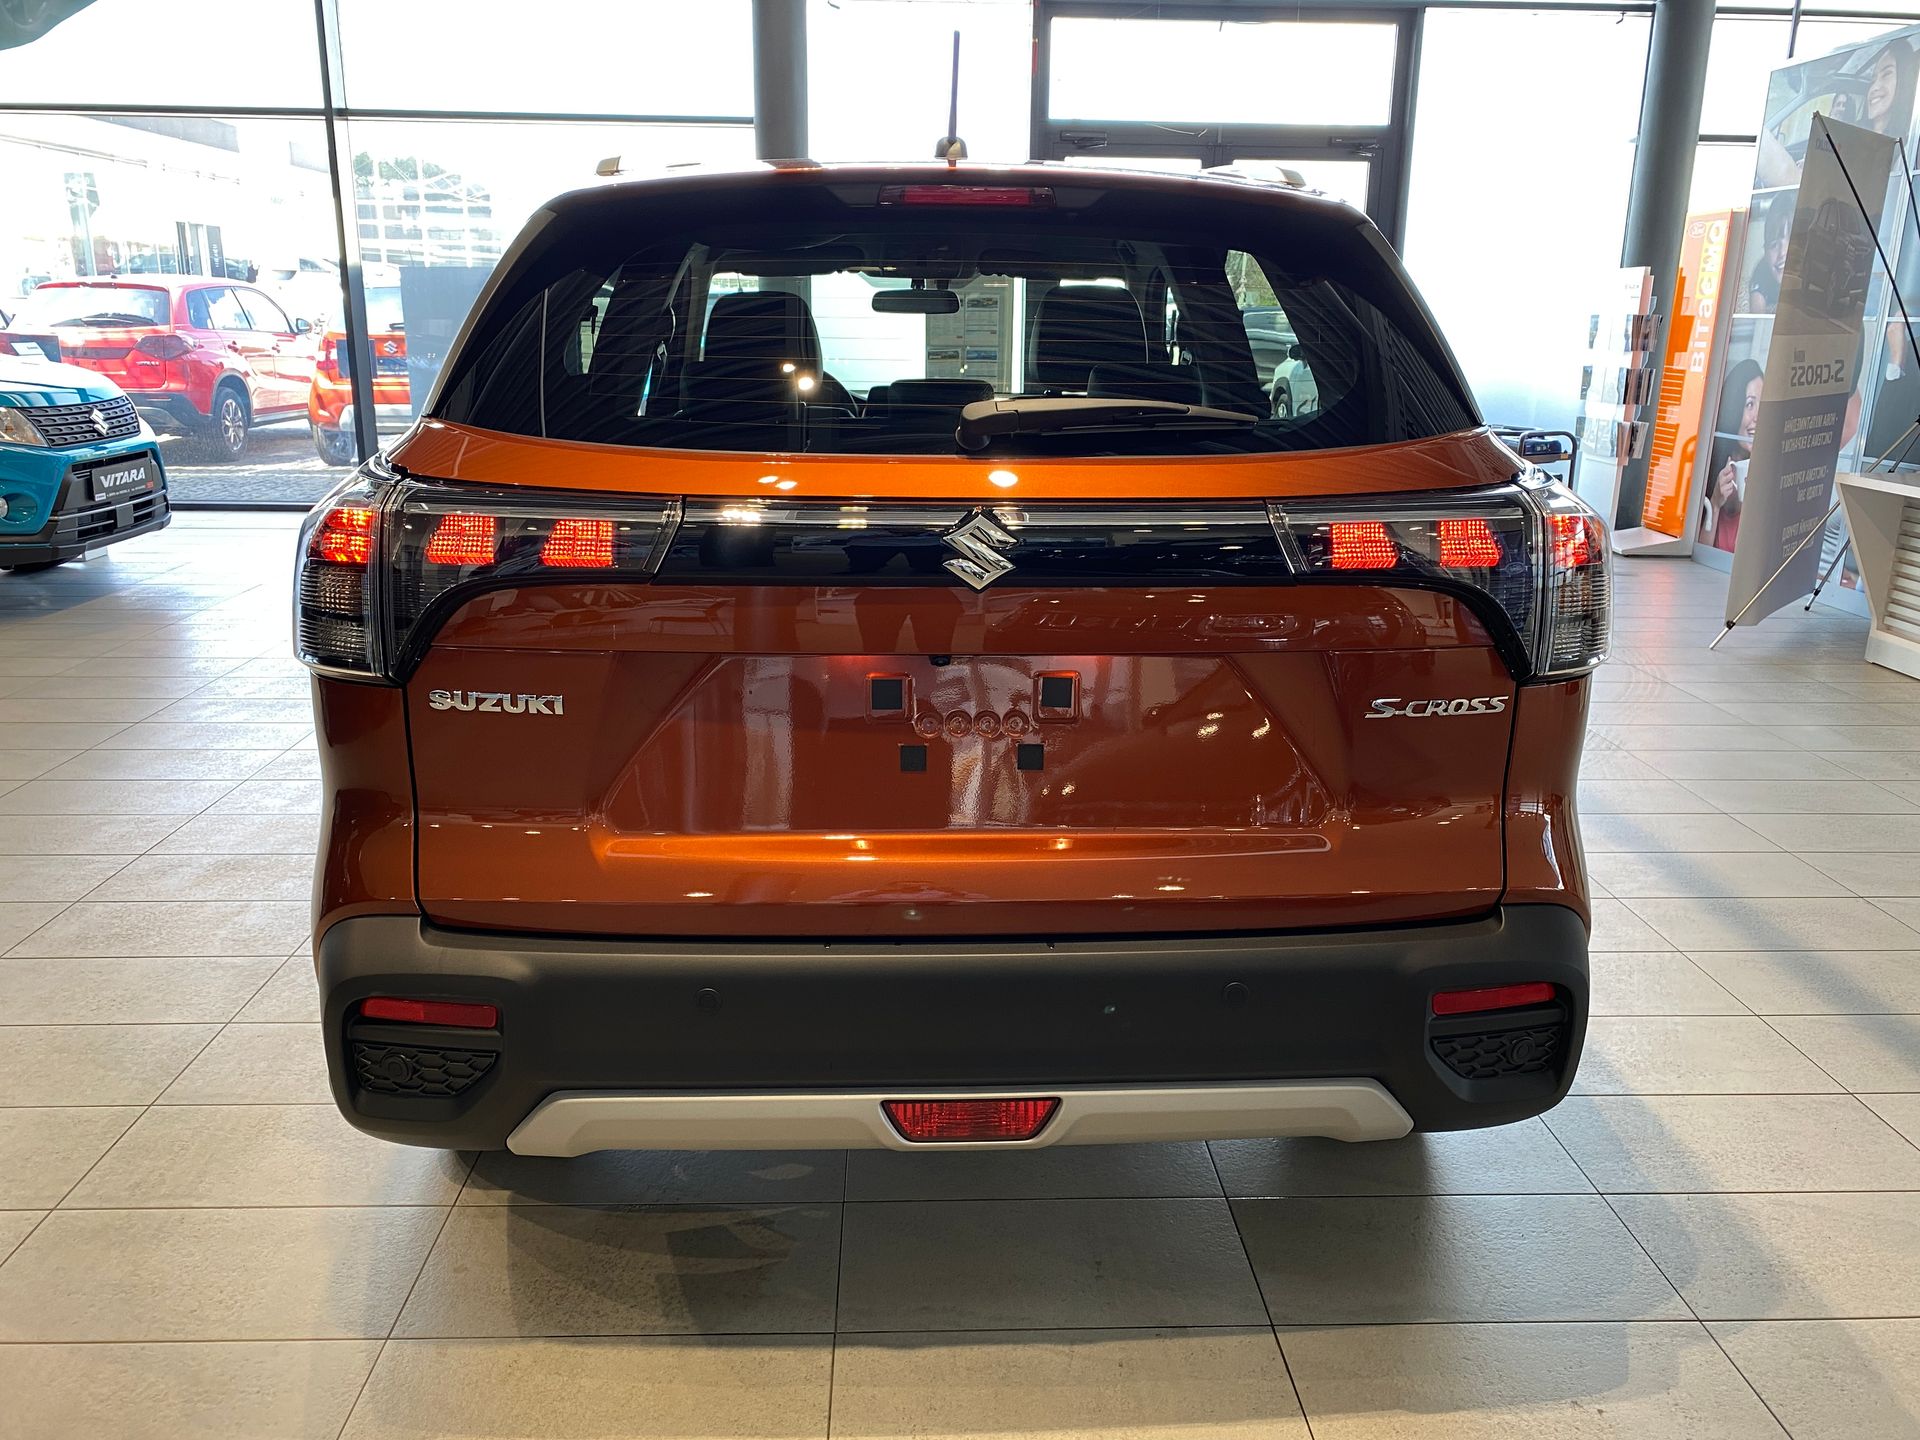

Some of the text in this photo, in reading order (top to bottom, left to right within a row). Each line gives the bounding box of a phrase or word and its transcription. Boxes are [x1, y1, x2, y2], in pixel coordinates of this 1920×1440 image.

[100, 467, 146, 488] VITARA
[428, 689, 564, 715] SUZUKI
[1364, 695, 1509, 719] S-CROSS
